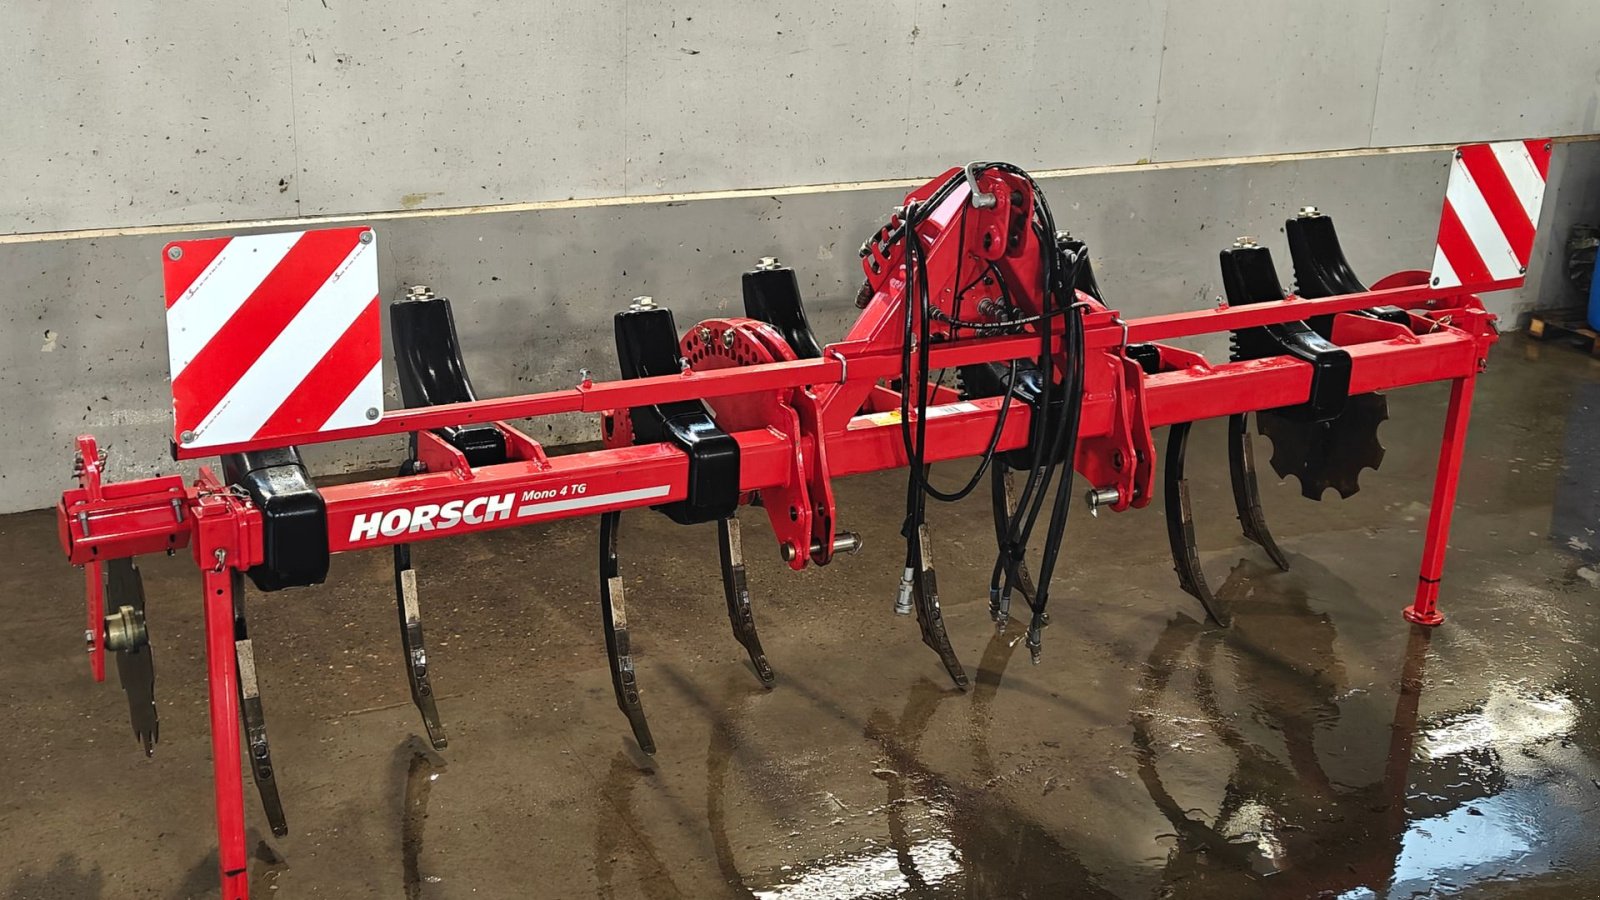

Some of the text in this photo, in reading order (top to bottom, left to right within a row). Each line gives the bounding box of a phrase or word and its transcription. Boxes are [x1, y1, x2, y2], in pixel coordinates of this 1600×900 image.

[521, 483, 587, 502] Mono 4 TG
[348, 492, 516, 543] HORSCH
